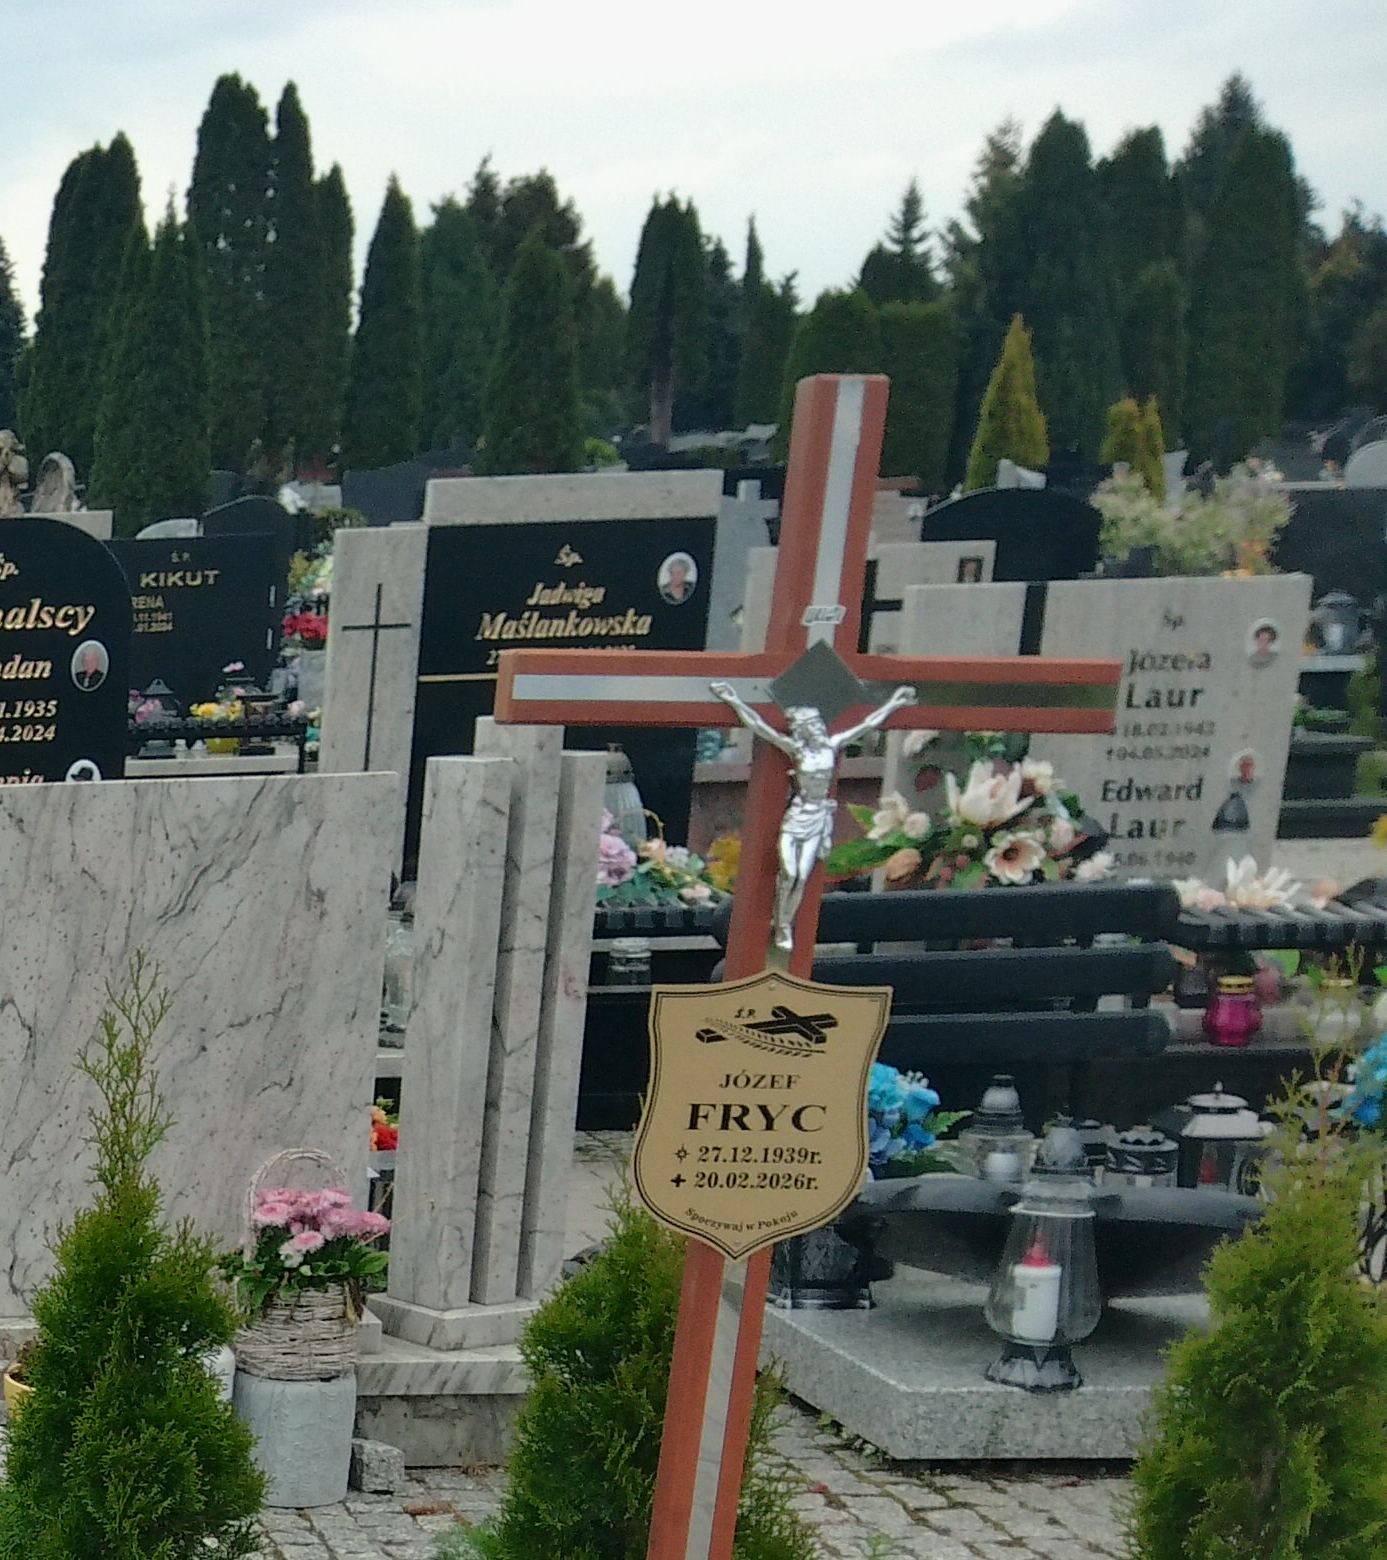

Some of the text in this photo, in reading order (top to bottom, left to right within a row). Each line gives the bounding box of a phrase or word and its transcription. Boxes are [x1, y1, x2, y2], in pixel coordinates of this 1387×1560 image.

[139, 568, 221, 588] KIKUT
[131, 594, 165, 609] RENA
[526, 580, 607, 609] Jadwiga
[474, 607, 653, 641] Maślankowska
[1125, 682, 1205, 709] Laur
[1101, 776, 1204, 802] Edward
[1108, 812, 1187, 840] Laur
[718, 1069, 802, 1090] JÓZEF
[684, 1102, 827, 1133] FRYC
[697, 1145, 823, 1165] 27.12.1939r.
[694, 1171, 820, 1190] 20.02.2026r.
[684, 1206, 745, 1233] Spoczywaj
[757, 1209, 800, 1231] Pokoju
